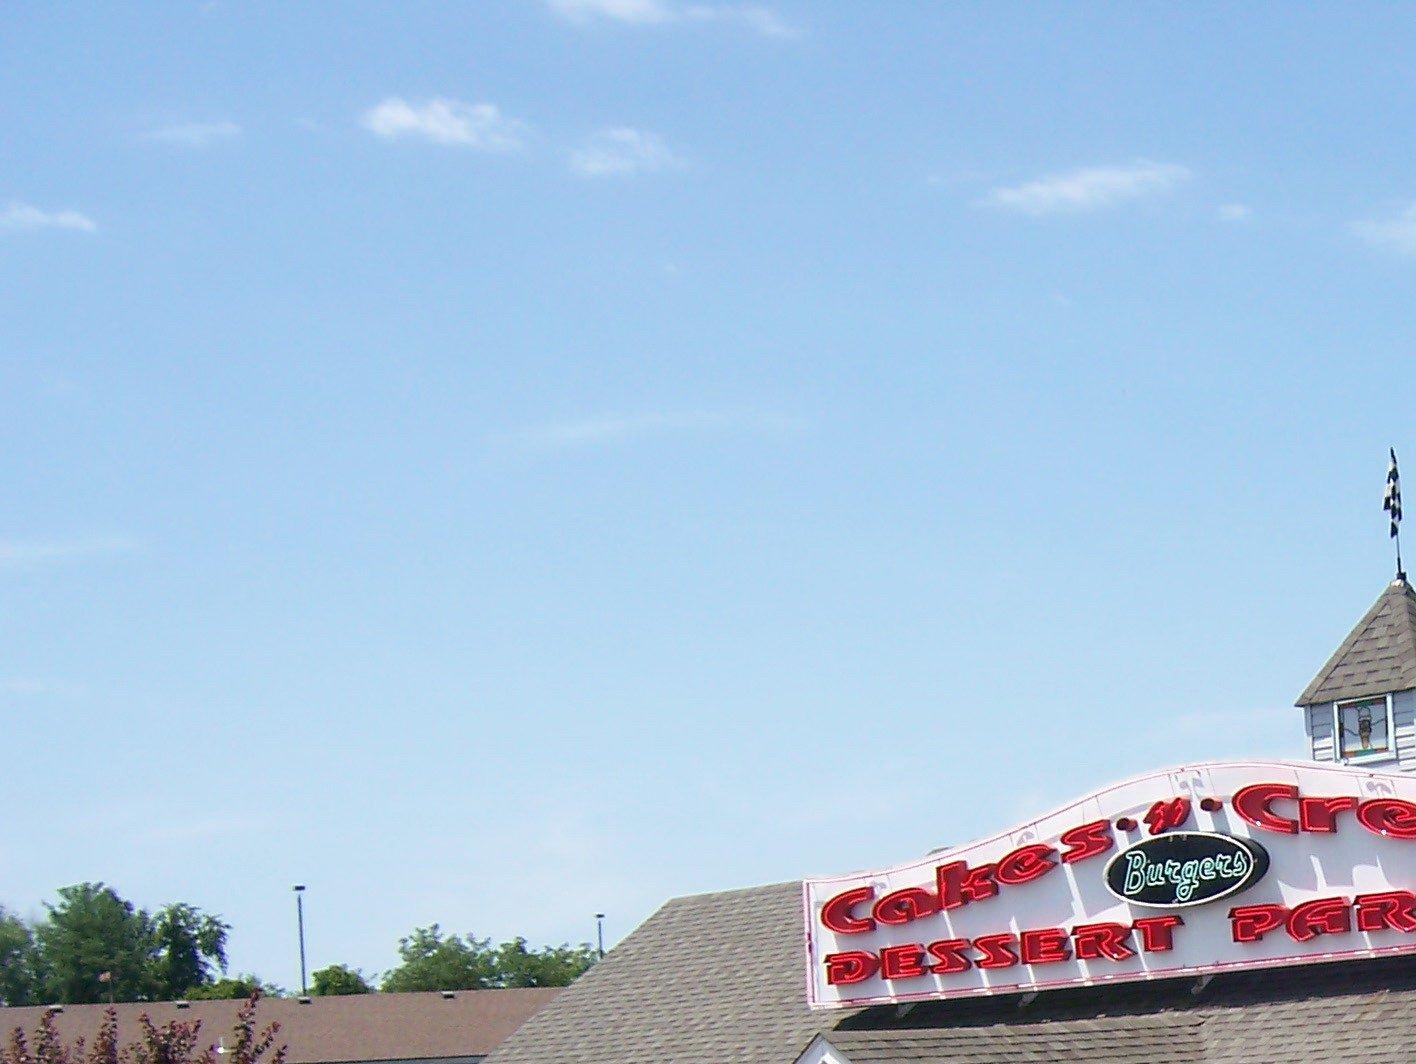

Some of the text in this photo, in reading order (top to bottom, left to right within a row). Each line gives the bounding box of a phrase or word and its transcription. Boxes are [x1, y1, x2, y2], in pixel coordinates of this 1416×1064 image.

[820, 818, 1114, 937] Cakes
[1122, 849, 1248, 902] Burgers
[823, 913, 1186, 989] DESSERT
